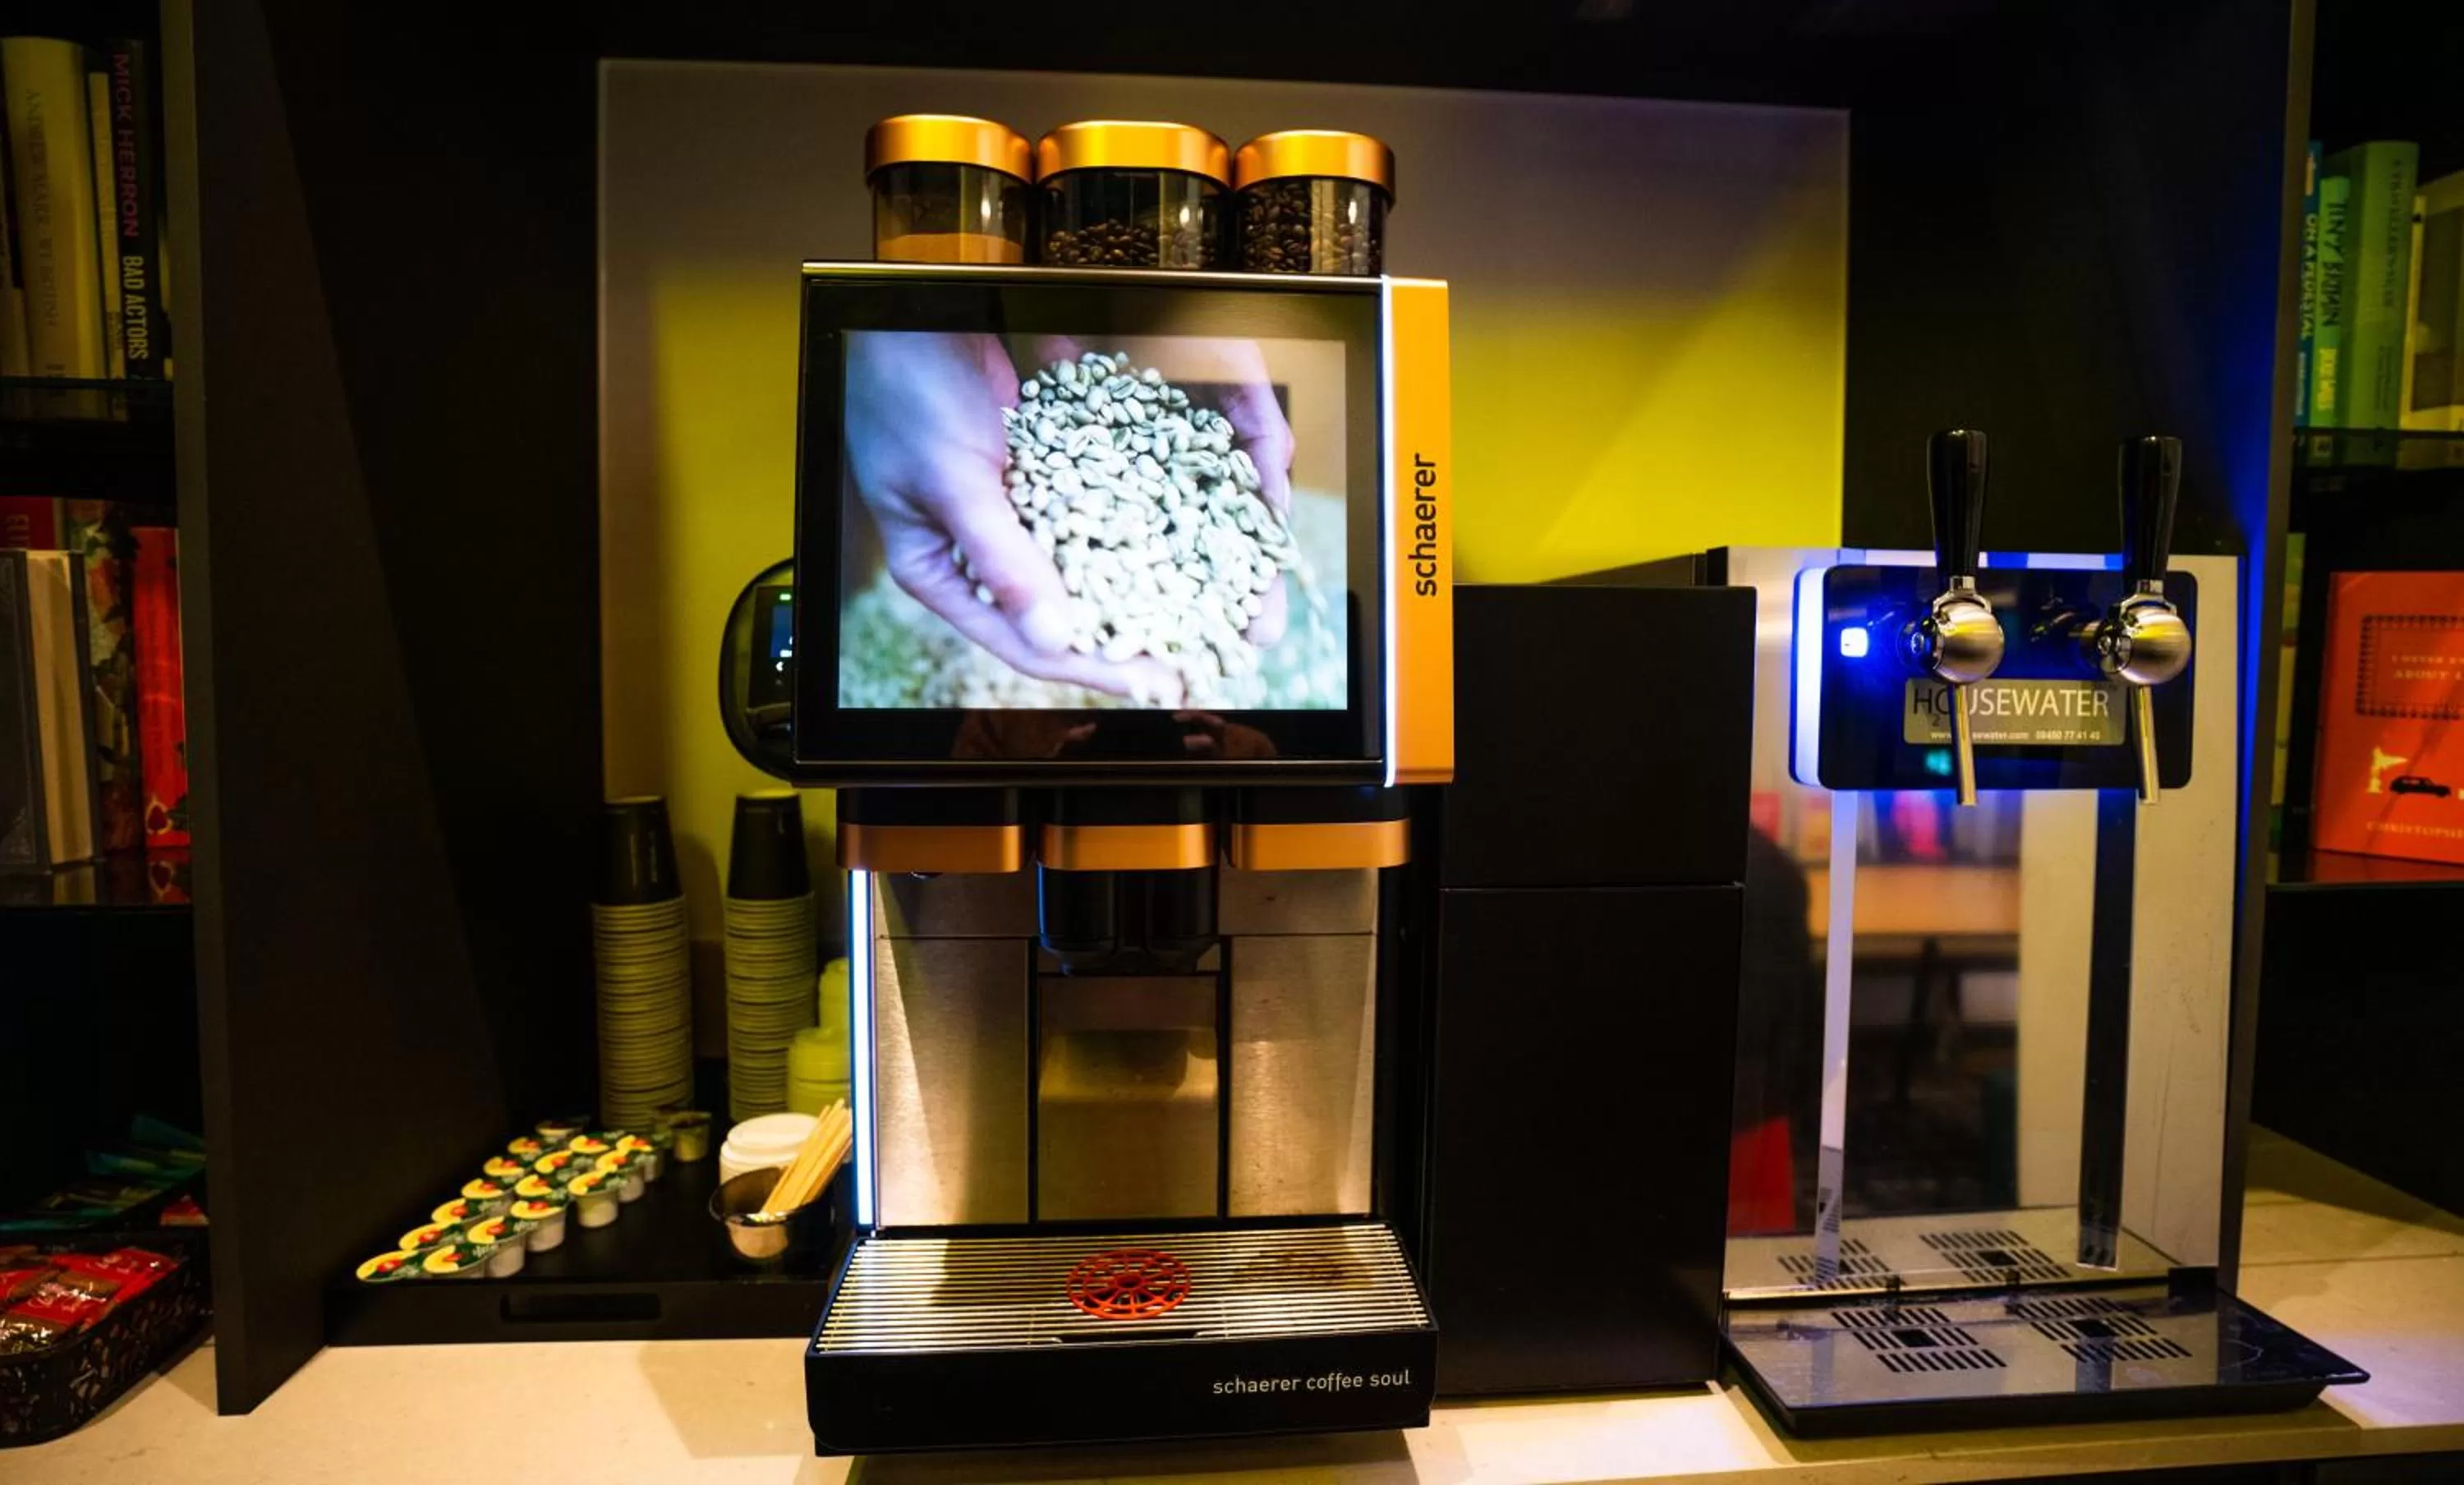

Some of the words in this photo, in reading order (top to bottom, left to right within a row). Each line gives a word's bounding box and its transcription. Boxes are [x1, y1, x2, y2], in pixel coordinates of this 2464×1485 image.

[112, 53, 132, 122] MICK
[117, 130, 139, 237] HERRON
[122, 255, 144, 290] BAD
[125, 294, 149, 360] ACTORS
[1408, 453, 1437, 596] schaerer
[1212, 1376, 1302, 1395] schaerer
[1307, 1372, 1363, 1392] coffee
[1369, 1369, 1411, 1386] soul
